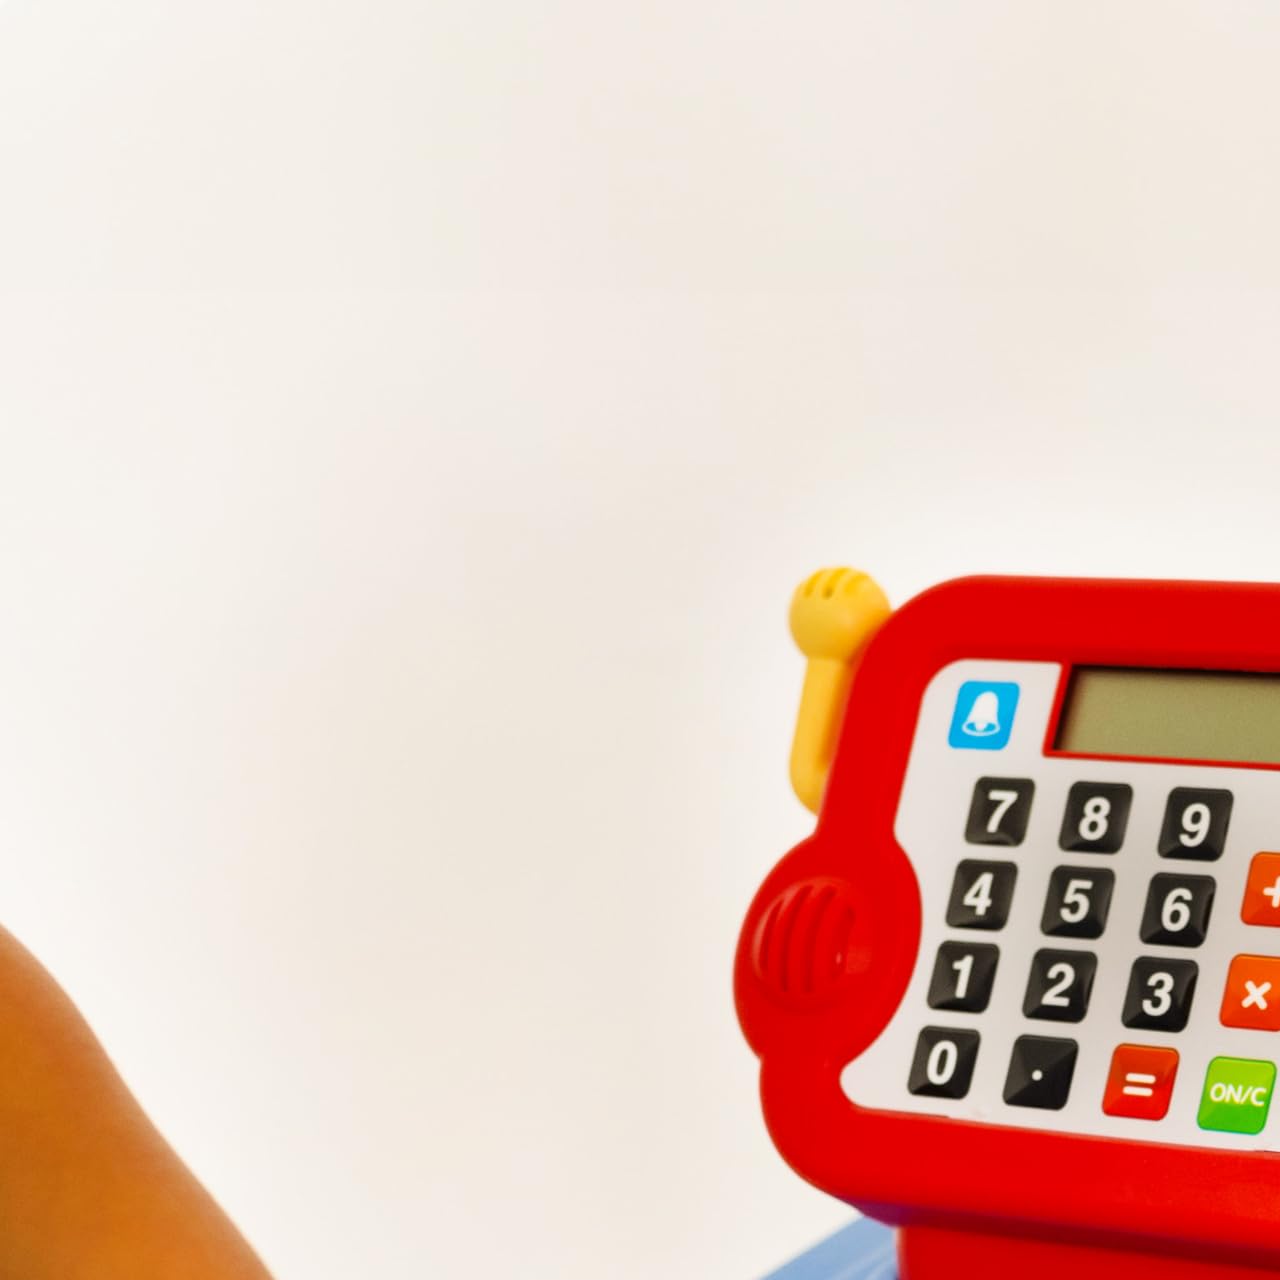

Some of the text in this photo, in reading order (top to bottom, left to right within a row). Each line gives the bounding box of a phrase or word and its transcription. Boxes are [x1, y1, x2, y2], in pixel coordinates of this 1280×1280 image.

[987, 790, 1018, 833] 7
[1079, 797, 1111, 841] 8
[1179, 803, 1211, 847] 9
[963, 872, 994, 916] 4
[1060, 879, 1093, 923] 5
[1161, 887, 1193, 932] 6
[952, 955, 974, 999] 1
[1041, 963, 1075, 1007] 2
[1142, 972, 1174, 1017] 3
[926, 1040, 958, 1085] 0
[1210, 1082, 1266, 1107] ON/C
